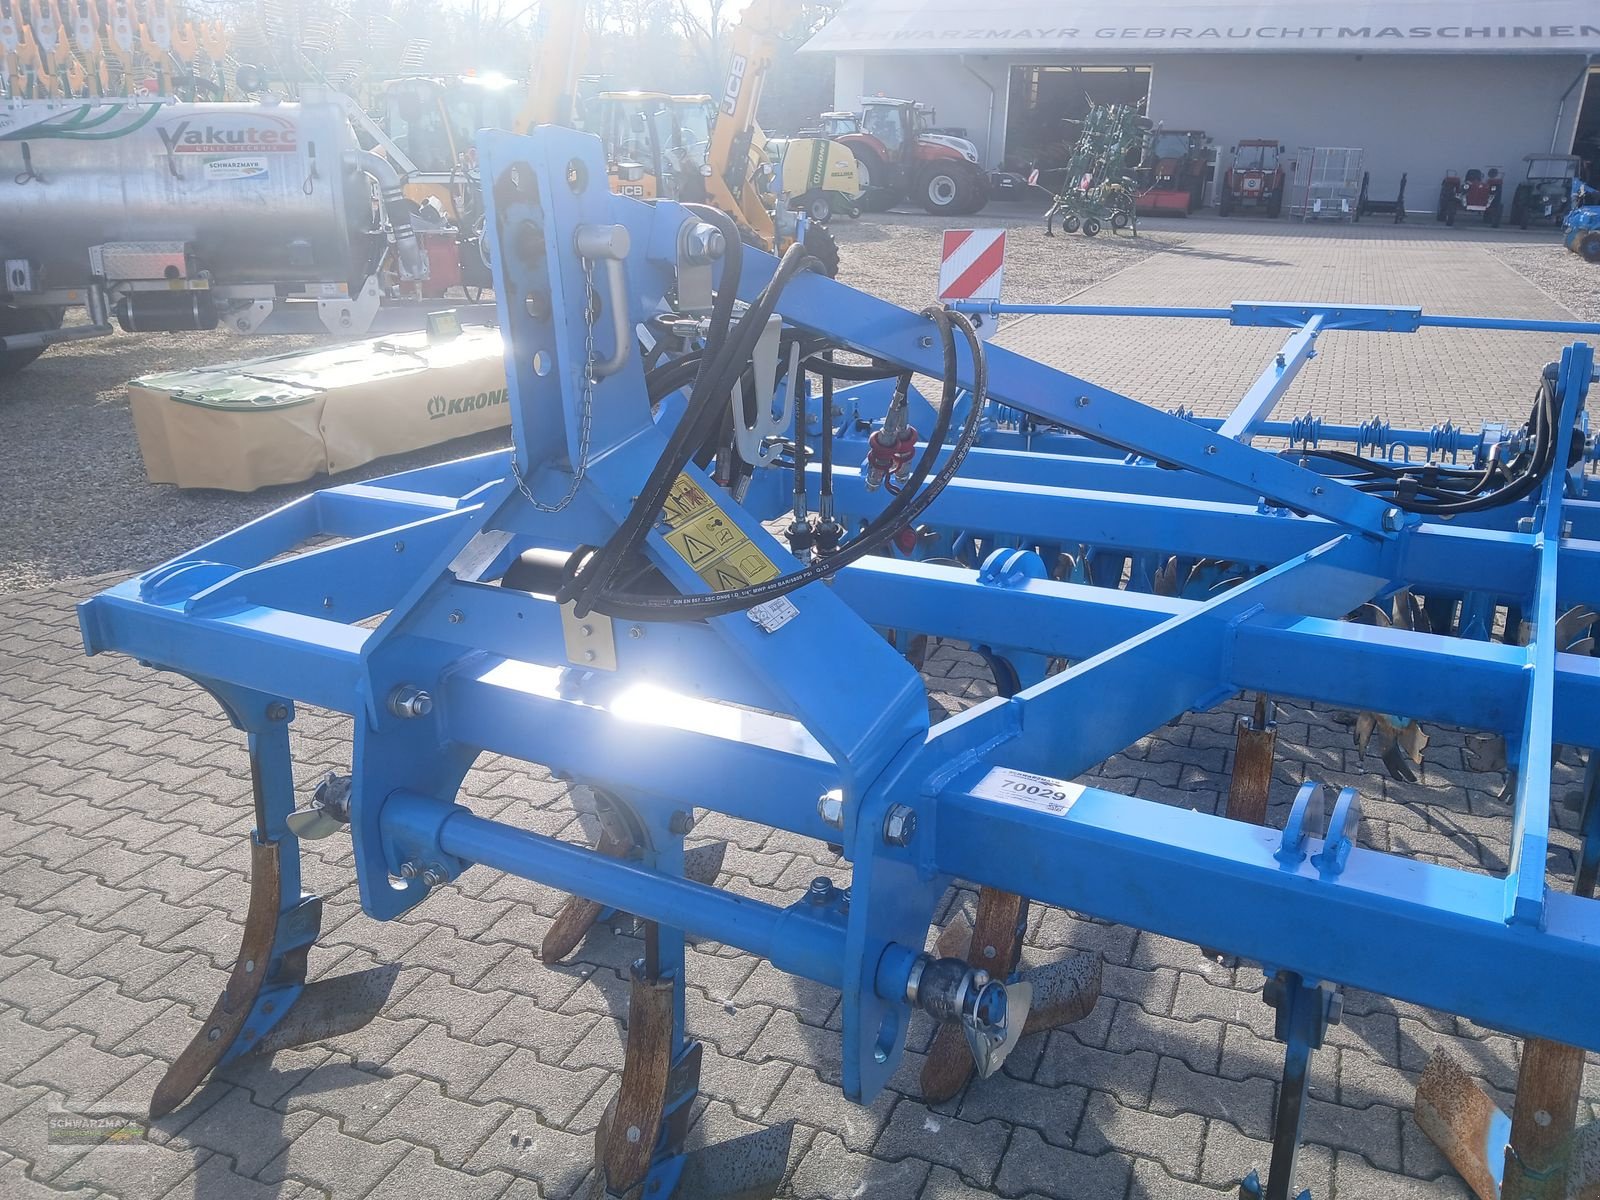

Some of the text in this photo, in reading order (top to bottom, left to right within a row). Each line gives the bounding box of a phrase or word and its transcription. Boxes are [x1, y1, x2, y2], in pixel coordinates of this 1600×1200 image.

[724, 55, 746, 115] JCB
[156, 121, 297, 155] Vakutec
[617, 185, 643, 196] JCB
[447, 388, 509, 416] KRONE
[1001, 779, 1066, 801] 70029
